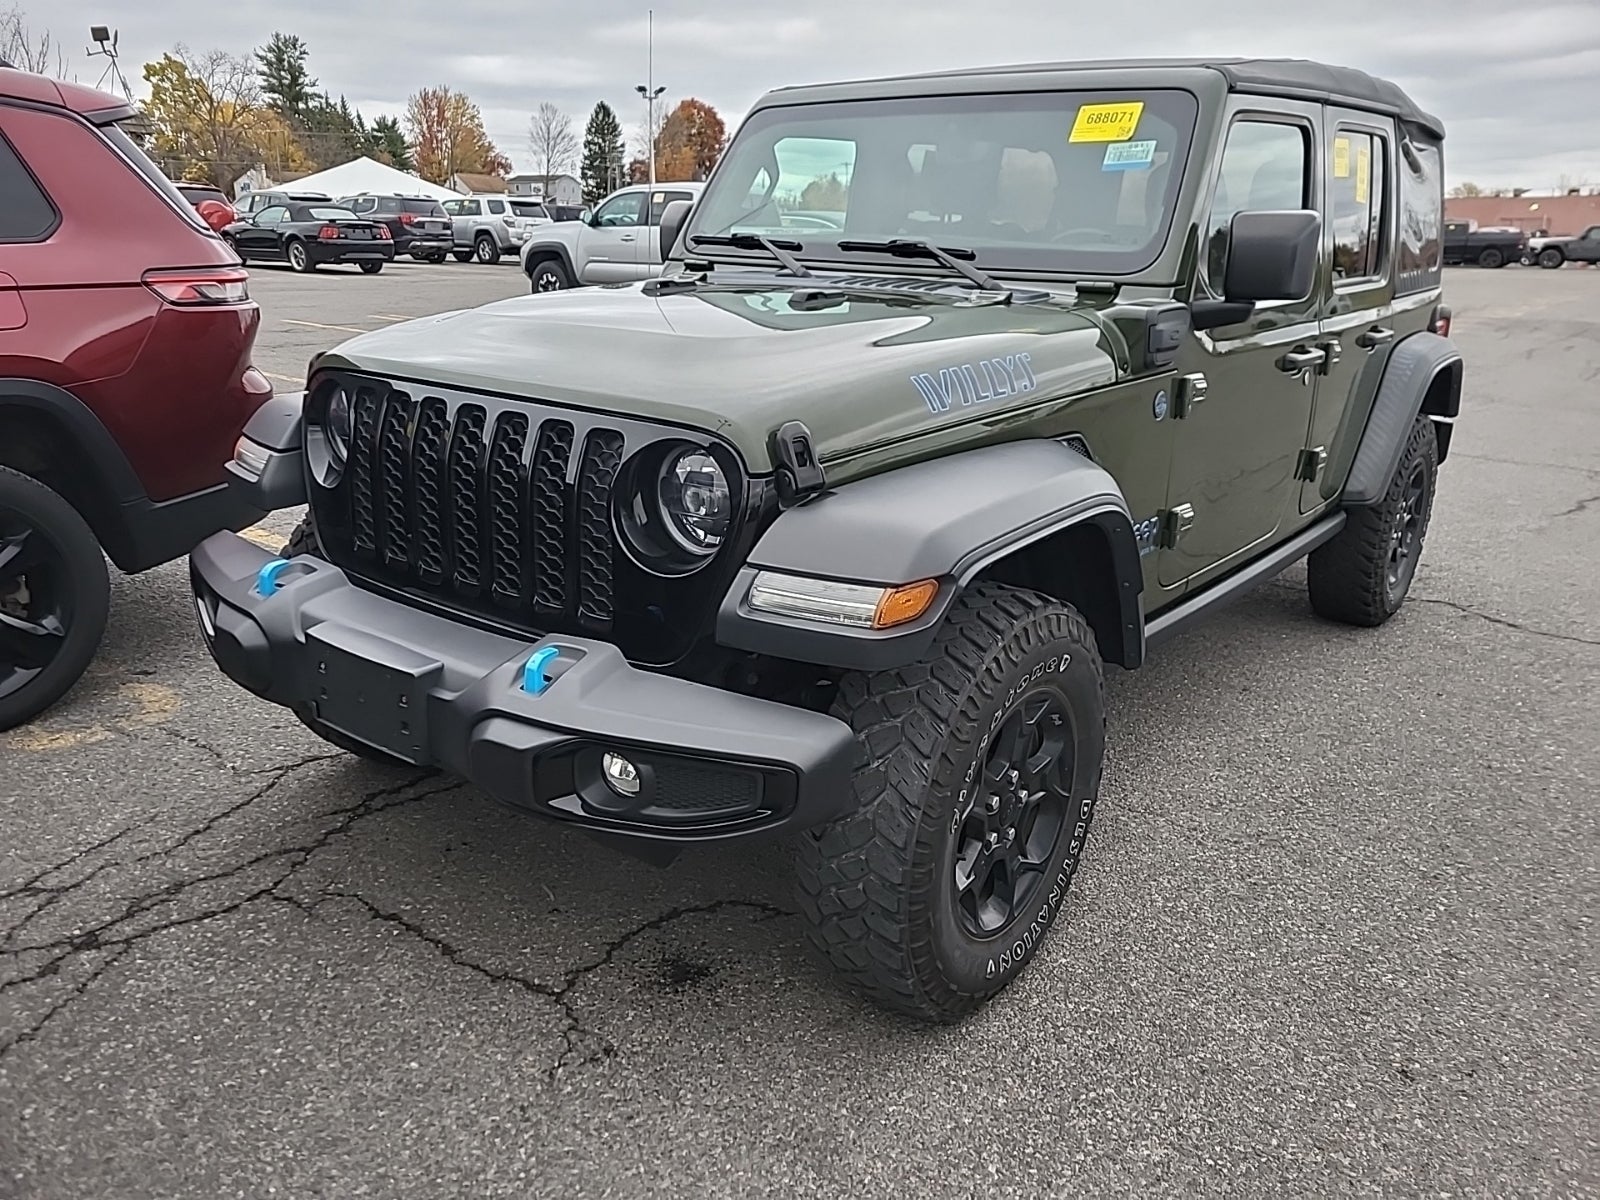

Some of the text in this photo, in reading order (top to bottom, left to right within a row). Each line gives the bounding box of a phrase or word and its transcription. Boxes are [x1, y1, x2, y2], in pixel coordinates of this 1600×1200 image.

[1086, 111, 1135, 125] 688071
[910, 353, 1036, 413] WILLYS
[999, 799, 1092, 973] DESTINATION
